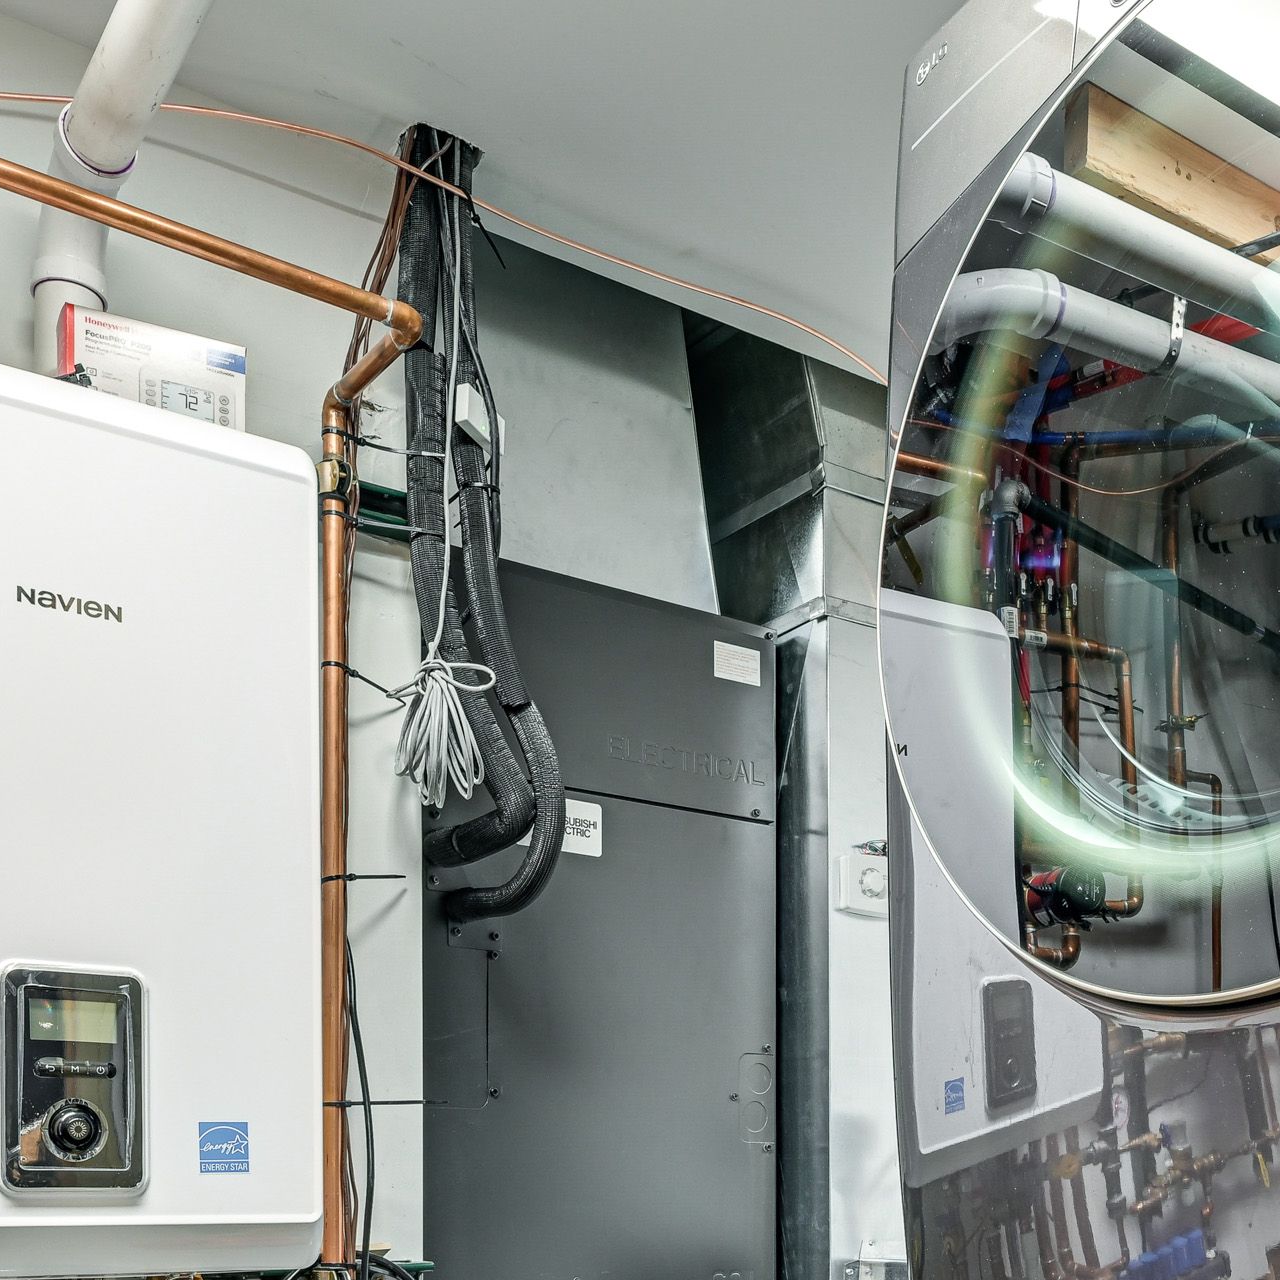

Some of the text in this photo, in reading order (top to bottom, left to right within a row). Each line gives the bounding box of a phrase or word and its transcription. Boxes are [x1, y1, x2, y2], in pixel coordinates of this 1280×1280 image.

[84, 316, 130, 332] Honeywell
[179, 392, 199, 411] 72
[608, 735, 766, 787] ELECTRICAL
[565, 817, 598, 830] SUBISHI
[565, 826, 591, 838] CTRIC
[201, 1162, 248, 1171] ENERGY STAR
